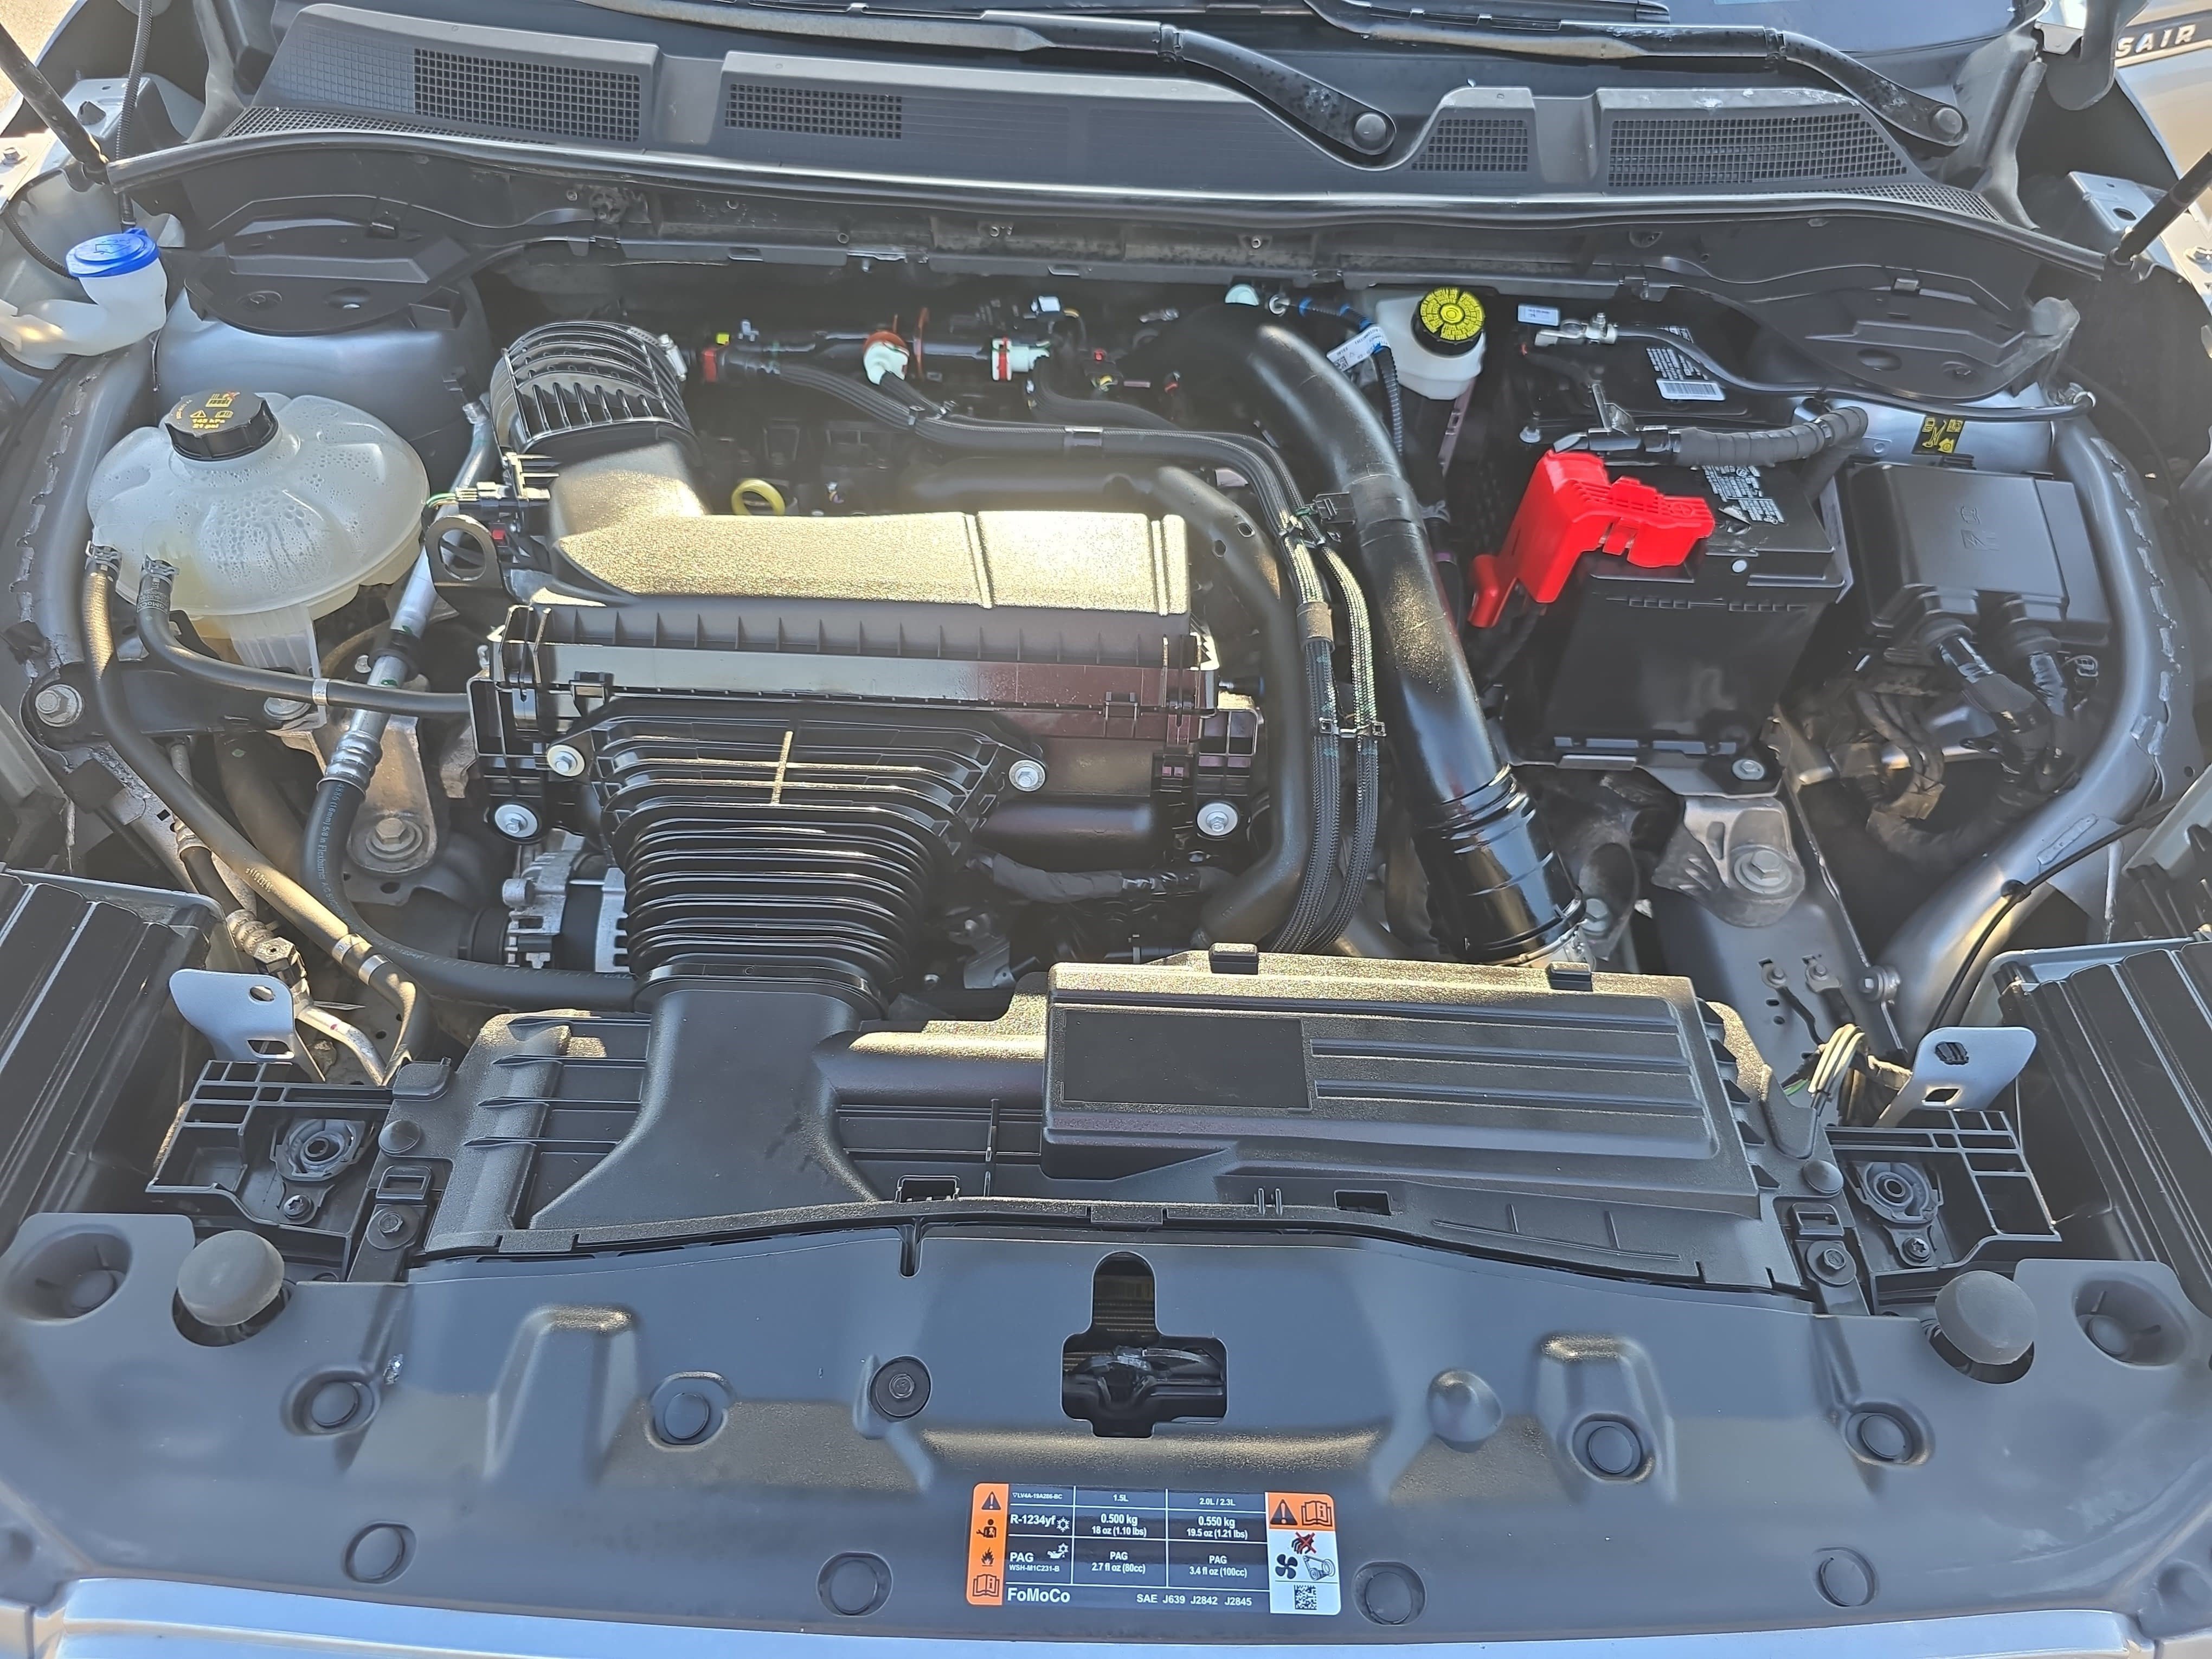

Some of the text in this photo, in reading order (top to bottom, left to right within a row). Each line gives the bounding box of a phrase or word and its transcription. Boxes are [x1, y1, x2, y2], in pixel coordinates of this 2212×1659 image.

[332, 783, 345, 801] 4886
[323, 802, 338, 826] (16mm)
[321, 826, 330, 837] 5/8
[1113, 1494, 1129, 1502] 1.5L
[1220, 1498, 1236, 1506] 2.3L
[1010, 1514, 1056, 1527] R-1234yf
[1101, 1513, 1138, 1527] 0.500 kg
[1198, 1515, 1236, 1529] 0.550 kg
[1091, 1525, 1101, 1534] 18
[1113, 1526, 1131, 1536] (1.10
[1132, 1527, 1147, 1538] lbs)
[1186, 1528, 1203, 1537] 19.5
[1214, 1528, 1232, 1539] (1.21
[1233, 1529, 1248, 1540] lbs)
[1009, 1552, 1034, 1562] PAG
[1110, 1551, 1128, 1560] PAG
[1208, 1555, 1227, 1564] PAG
[1091, 1562, 1104, 1571] 2.7
[1104, 1562, 1110, 1571] fl
[1122, 1563, 1146, 1574] (80cc)
[1189, 1566, 1201, 1575] 3.4
[1202, 1566, 1208, 1575] fl
[1219, 1567, 1248, 1579] (100cc)
[1007, 1587, 1071, 1603] FoMoCo
[1136, 1593, 1252, 1606] SAE J639 J2842 J2845
